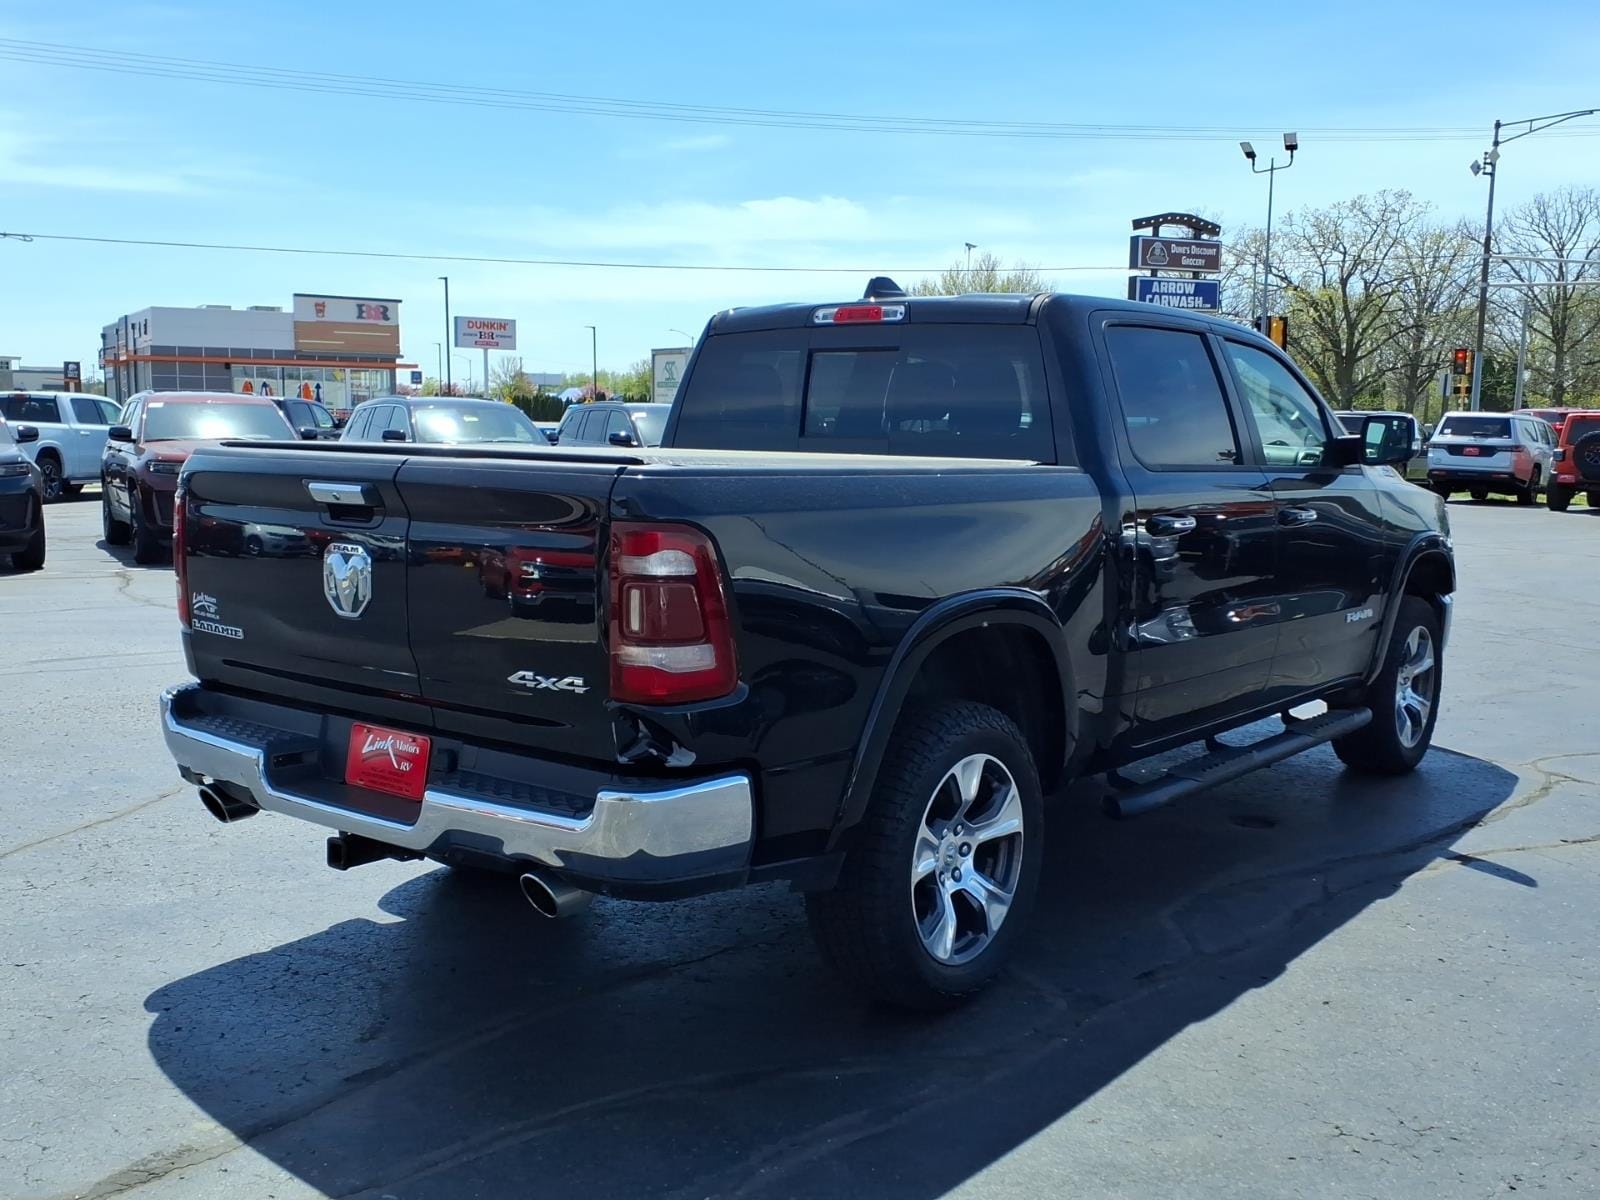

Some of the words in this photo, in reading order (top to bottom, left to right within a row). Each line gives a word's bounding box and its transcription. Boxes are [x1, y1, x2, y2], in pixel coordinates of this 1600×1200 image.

[1190, 245, 1217, 256] DISCOUNT
[1181, 256, 1206, 266] GROCERY
[1151, 281, 1196, 294] ARROW
[467, 320, 509, 331] DUNKIN'
[333, 544, 359, 552] RAM
[192, 618, 245, 639] LARAMIE
[361, 734, 398, 769] Link
[396, 739, 420, 754] Motors
[400, 761, 413, 772] RV
